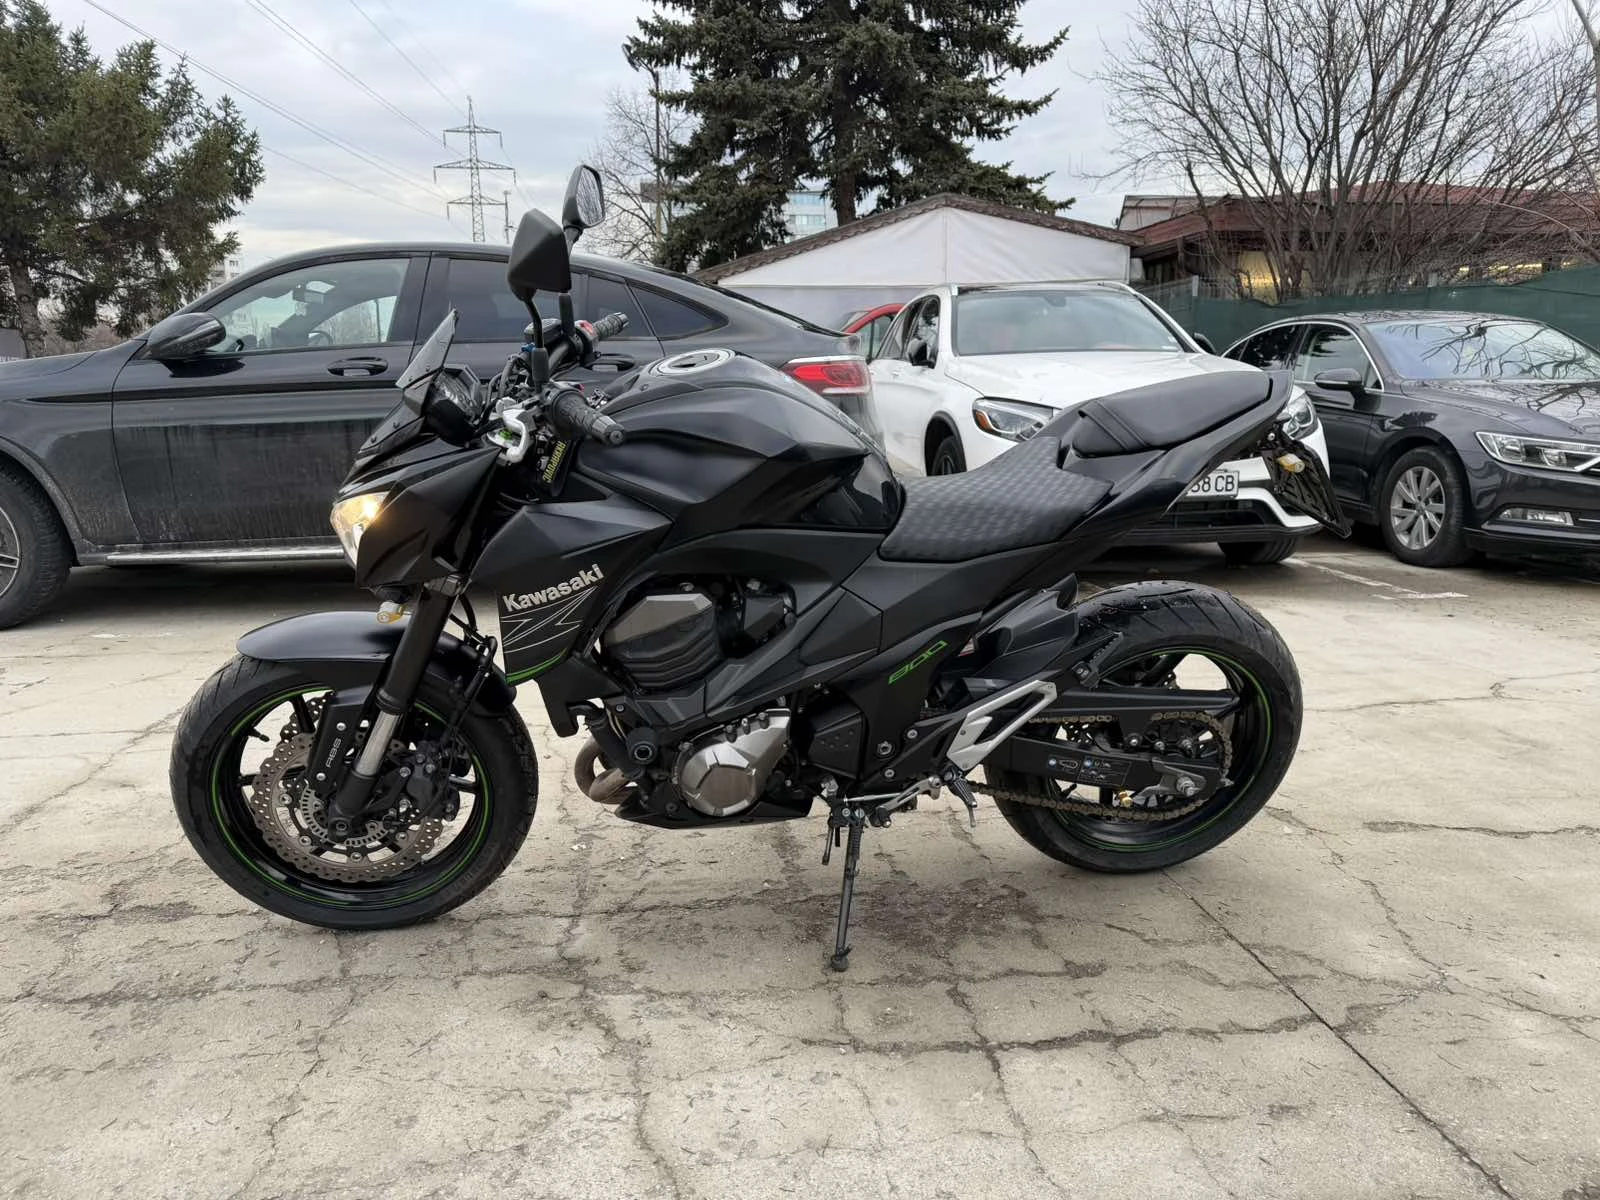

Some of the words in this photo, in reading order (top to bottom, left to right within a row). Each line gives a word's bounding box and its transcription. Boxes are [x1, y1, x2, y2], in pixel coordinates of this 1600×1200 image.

[1214, 475, 1235, 493] CB
[502, 563, 605, 612] Kawasaki
[887, 640, 949, 685] 800
[325, 737, 342, 768] ABS
